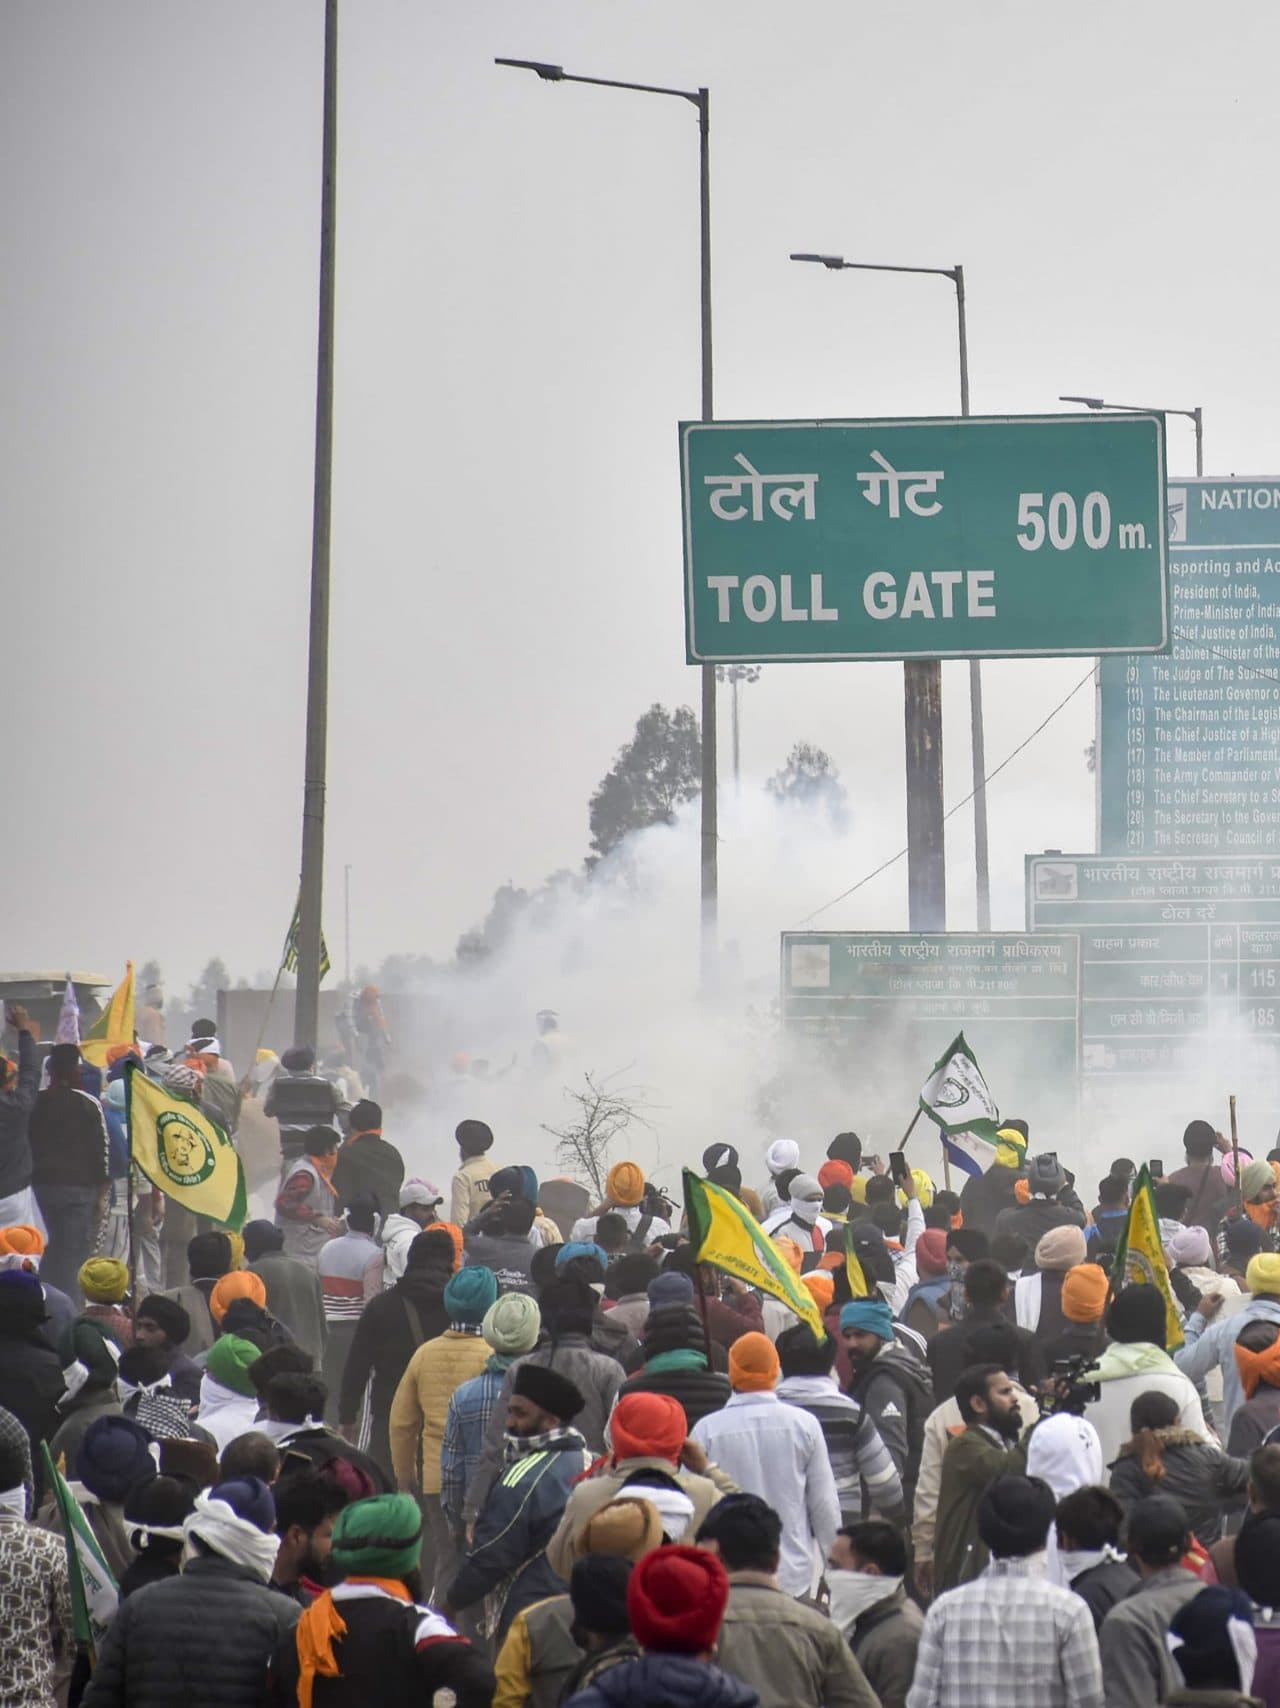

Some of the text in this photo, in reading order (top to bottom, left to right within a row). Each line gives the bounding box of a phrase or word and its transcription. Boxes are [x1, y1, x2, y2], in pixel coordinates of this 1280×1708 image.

[704, 451, 944, 521] टोल गेट
[1016, 491, 1111, 551] 500
[1235, 559, 1260, 574] and
[707, 570, 996, 623] TOLL GATE
[1174, 584, 1260, 599] President of India,
[1174, 605, 1242, 619] Prime-Minister
[1246, 605, 1254, 619] of
[1173, 626, 1276, 640] Chief Justice of India,
[1173, 647, 1209, 660] Cabinet
[1213, 647, 1250, 660] Minister
[1254, 647, 1263, 660] of
[1265, 647, 1279, 660] the
[1127, 667, 1139, 682] (9)
[1153, 666, 1169, 681] The
[1173, 667, 1201, 682] Judge
[1205, 666, 1214, 681] of
[1218, 666, 1234, 681] The
[1127, 729, 1144, 745] (15)
[1155, 727, 1171, 741] The
[1175, 727, 1200, 741] Chief
[1203, 727, 1237, 741] Justice
[1240, 727, 1250, 741] of
[1084, 864, 1139, 881] भारतीय
[1148, 862, 1196, 884] राष्ट्रीय
[1205, 863, 1263, 881] राजमार्ग
[847, 940, 1061, 960] भारतीय राष्ट्रीय राजमार्ग प्राधिकरण
[1250, 968, 1276, 988] 115
[1250, 1007, 1275, 1027] 185
